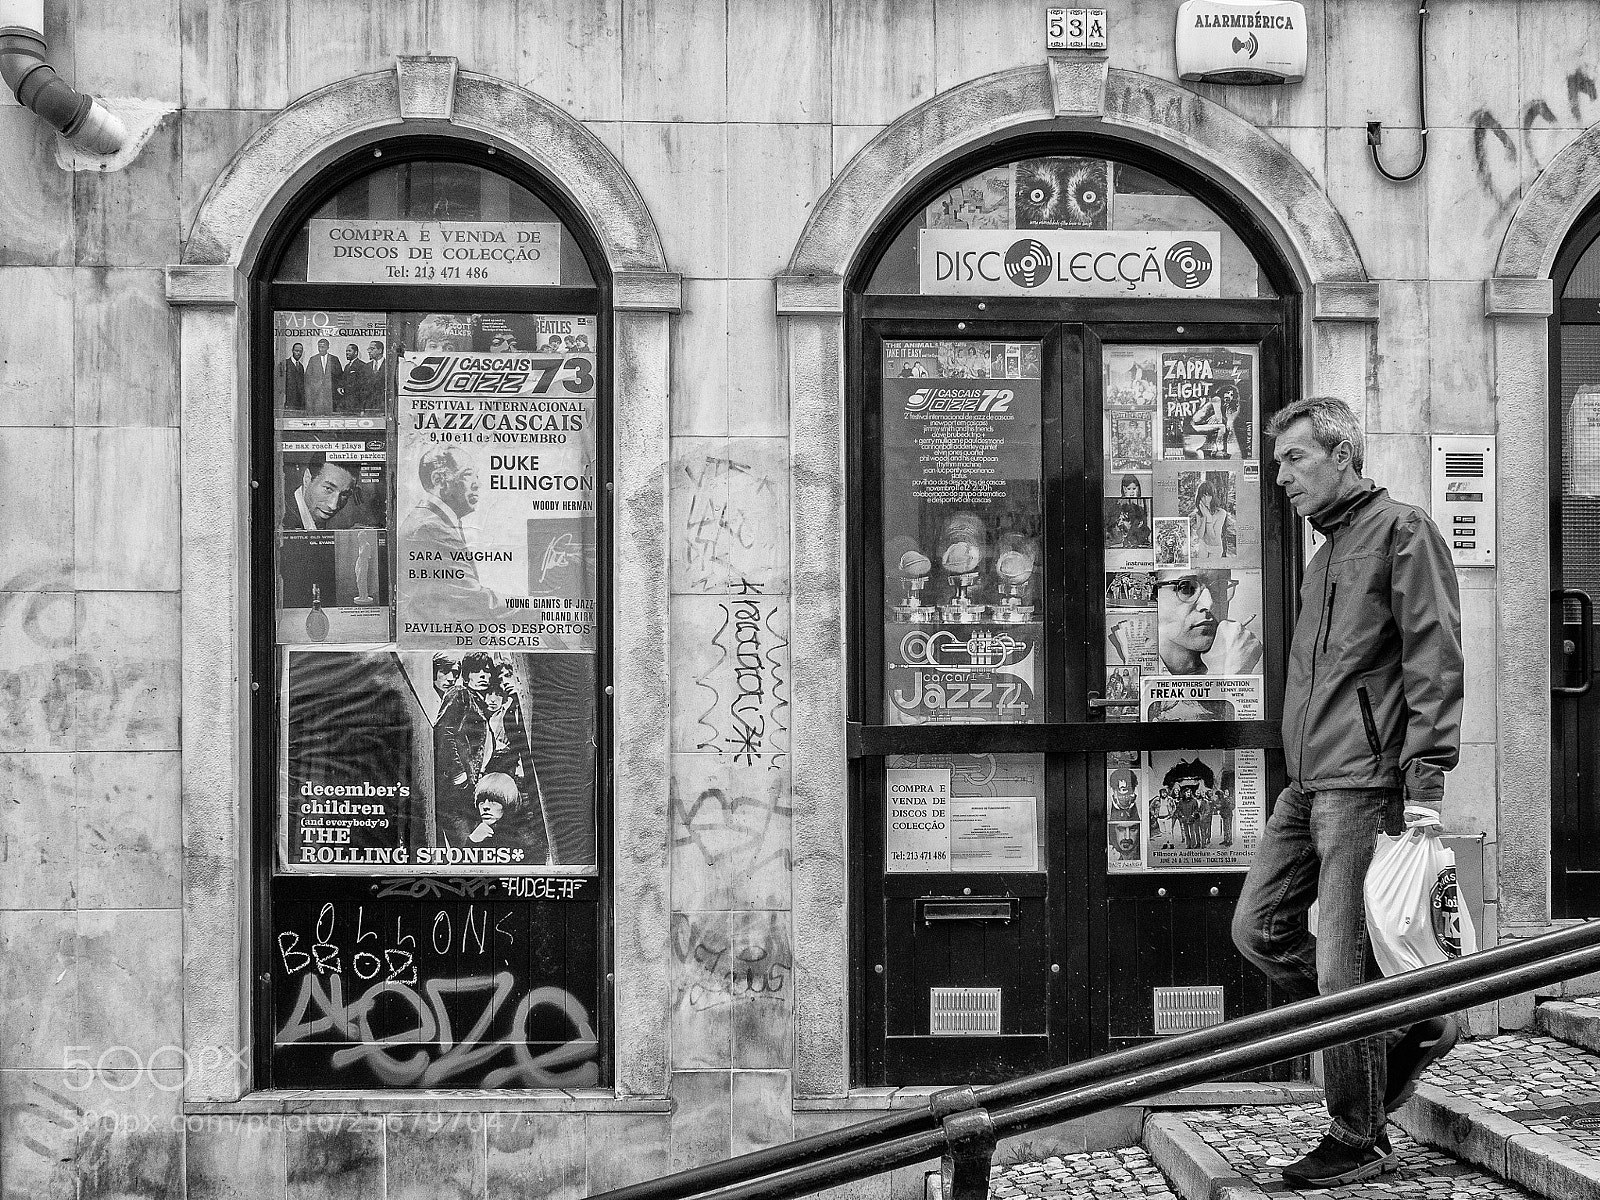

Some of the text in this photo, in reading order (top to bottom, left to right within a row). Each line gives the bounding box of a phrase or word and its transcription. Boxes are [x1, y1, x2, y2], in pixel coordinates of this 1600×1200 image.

[1194, 12, 1295, 32] ALARMIBÉRICA
[1049, 17, 1105, 41] 53A
[329, 228, 542, 244] COMPRA E VENDA DE
[333, 245, 541, 263] DISCOS DE COLECÇÃO
[385, 265, 488, 279] Tel: 213 471 486
[339, 328, 386, 337] QUARTET
[886, 349, 900, 358] TAKE
[901, 349, 906, 358] IT
[908, 349, 922, 358] EASY
[459, 358, 530, 371] CASCAIS
[1164, 360, 1213, 379] ZAPPA
[531, 357, 595, 394] 73
[938, 389, 981, 398] CASCAIS
[1168, 383, 1213, 398] LIGHT
[411, 400, 586, 412] FESTIVAL INTERNACIONAL
[978, 389, 1014, 412] 72
[288, 419, 374, 428] STEREO
[413, 413, 583, 432] JAZZ/CASCAIS
[492, 433, 567, 444] NOVEMBRO
[360, 452, 385, 460] parker
[490, 455, 539, 471] DUKE
[489, 474, 594, 491] ELLINGTON
[532, 500, 593, 511] WOODY HERMAN
[408, 551, 513, 562] SARA VAUGHAN
[505, 599, 594, 609] YOUNG GIANTS OF JAZZ
[541, 611, 594, 622] ROLAND KIRK
[404, 621, 590, 634] PAVILHÃO DOS DESPORTOS
[455, 636, 540, 646] DE CASCAIS
[924, 673, 970, 682] cascais
[893, 672, 993, 709] Jazz
[1150, 688, 1210, 698] FREAK OUT
[301, 782, 410, 797] december's
[892, 784, 946, 793] COMPRA E
[892, 797, 946, 805] VENDA DE
[301, 800, 385, 815] children
[892, 809, 946, 818] DISCOS DE
[301, 817, 324, 828] (and
[892, 820, 945, 831] COLECÇÃO
[301, 828, 350, 843] THE
[300, 847, 409, 864] ROLLING
[891, 851, 905, 860] Tel:
[906, 851, 918, 860] 213
[919, 851, 932, 860] 471
[934, 851, 947, 861] 486
